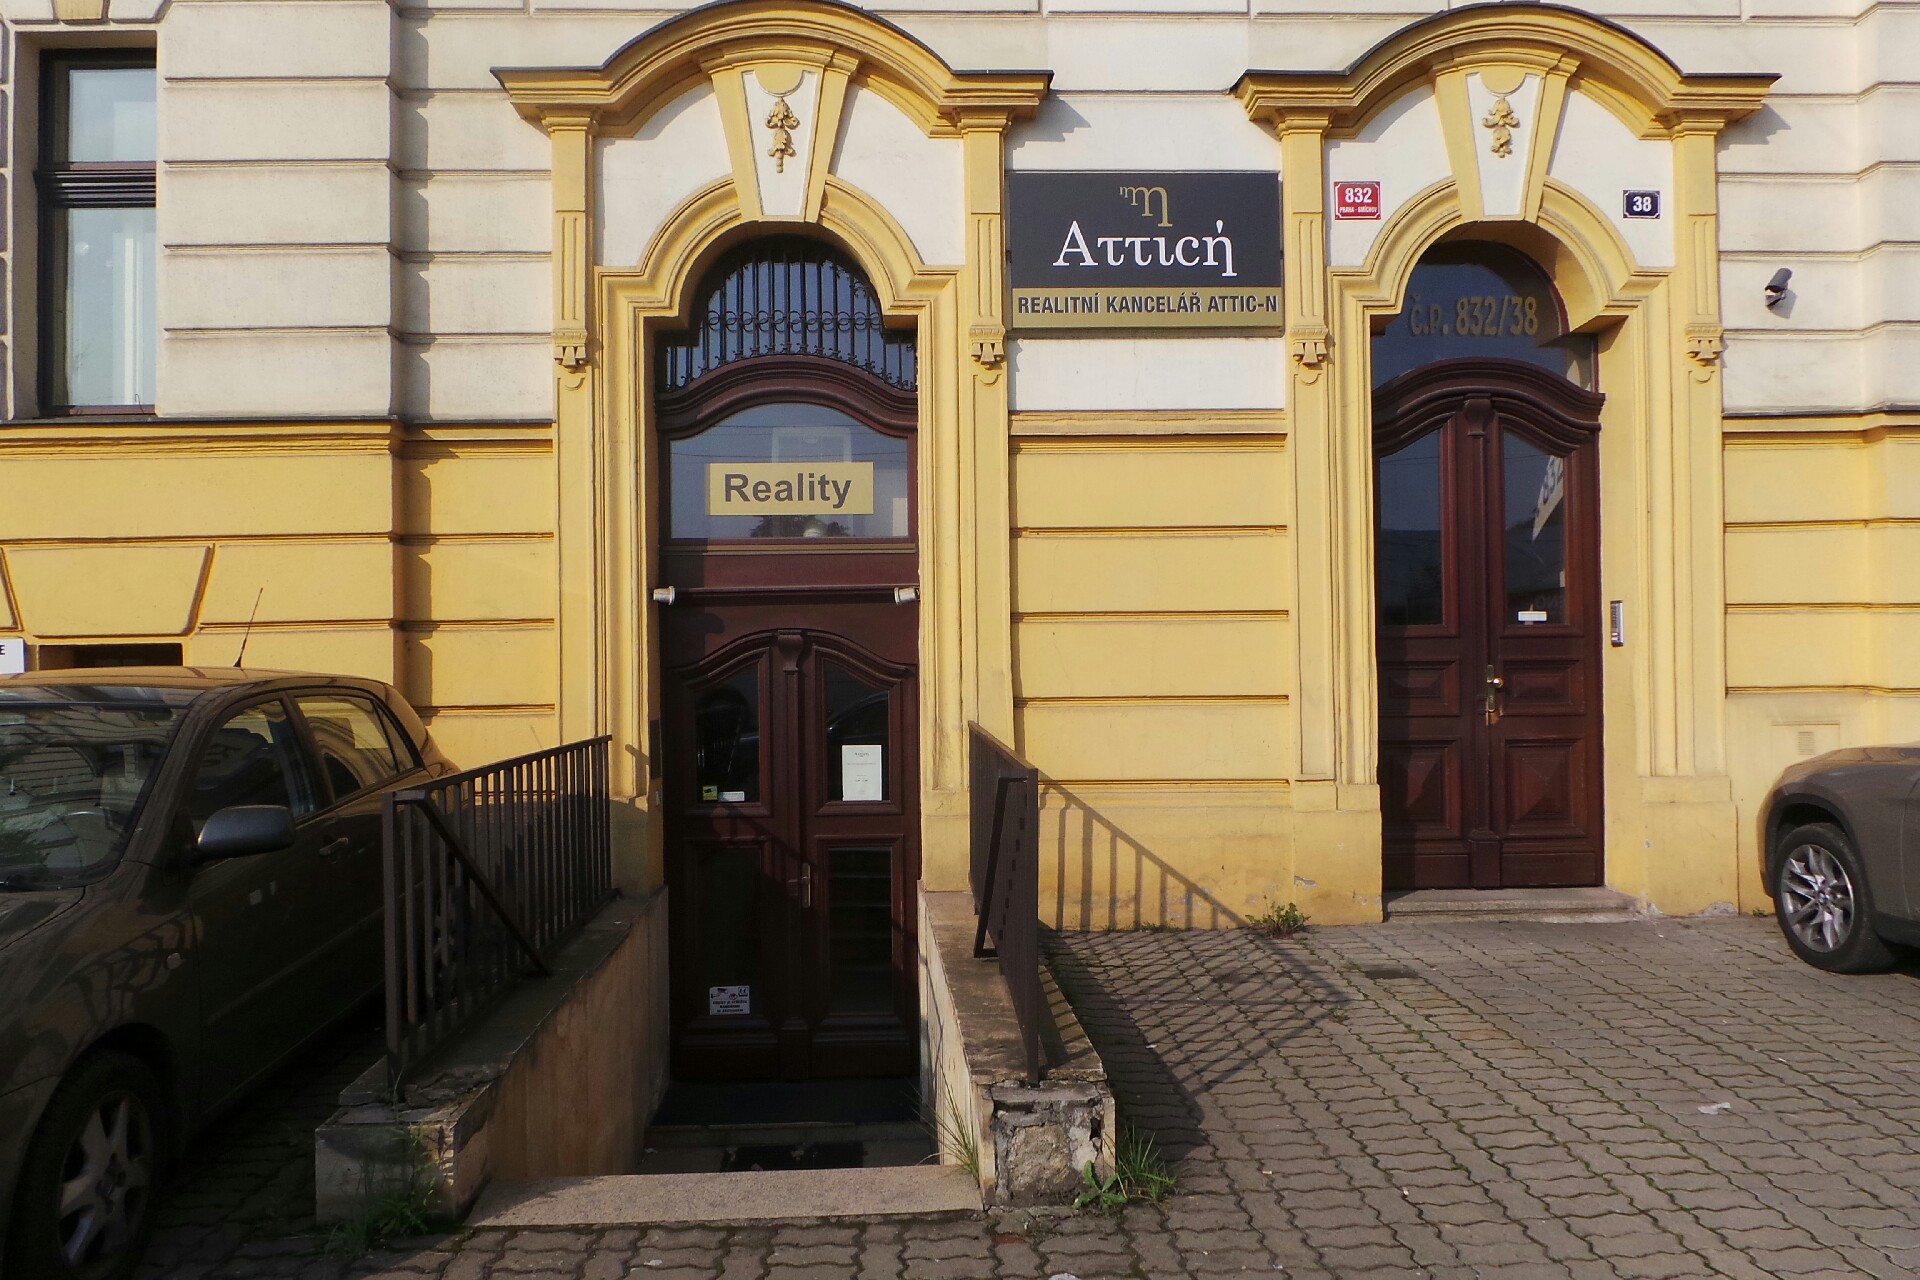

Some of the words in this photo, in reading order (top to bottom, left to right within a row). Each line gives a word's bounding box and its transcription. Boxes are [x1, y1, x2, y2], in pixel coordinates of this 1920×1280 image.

[1345, 187, 1372, 203] 832
[1633, 196, 1652, 212] 38
[1018, 293, 1099, 314] REALITNÍ
[1106, 291, 1201, 314] KANCELÁŘ
[1207, 294, 1279, 313] ATTIC-N
[1456, 296, 1538, 335] 832/38
[724, 473, 852, 509] Reality
